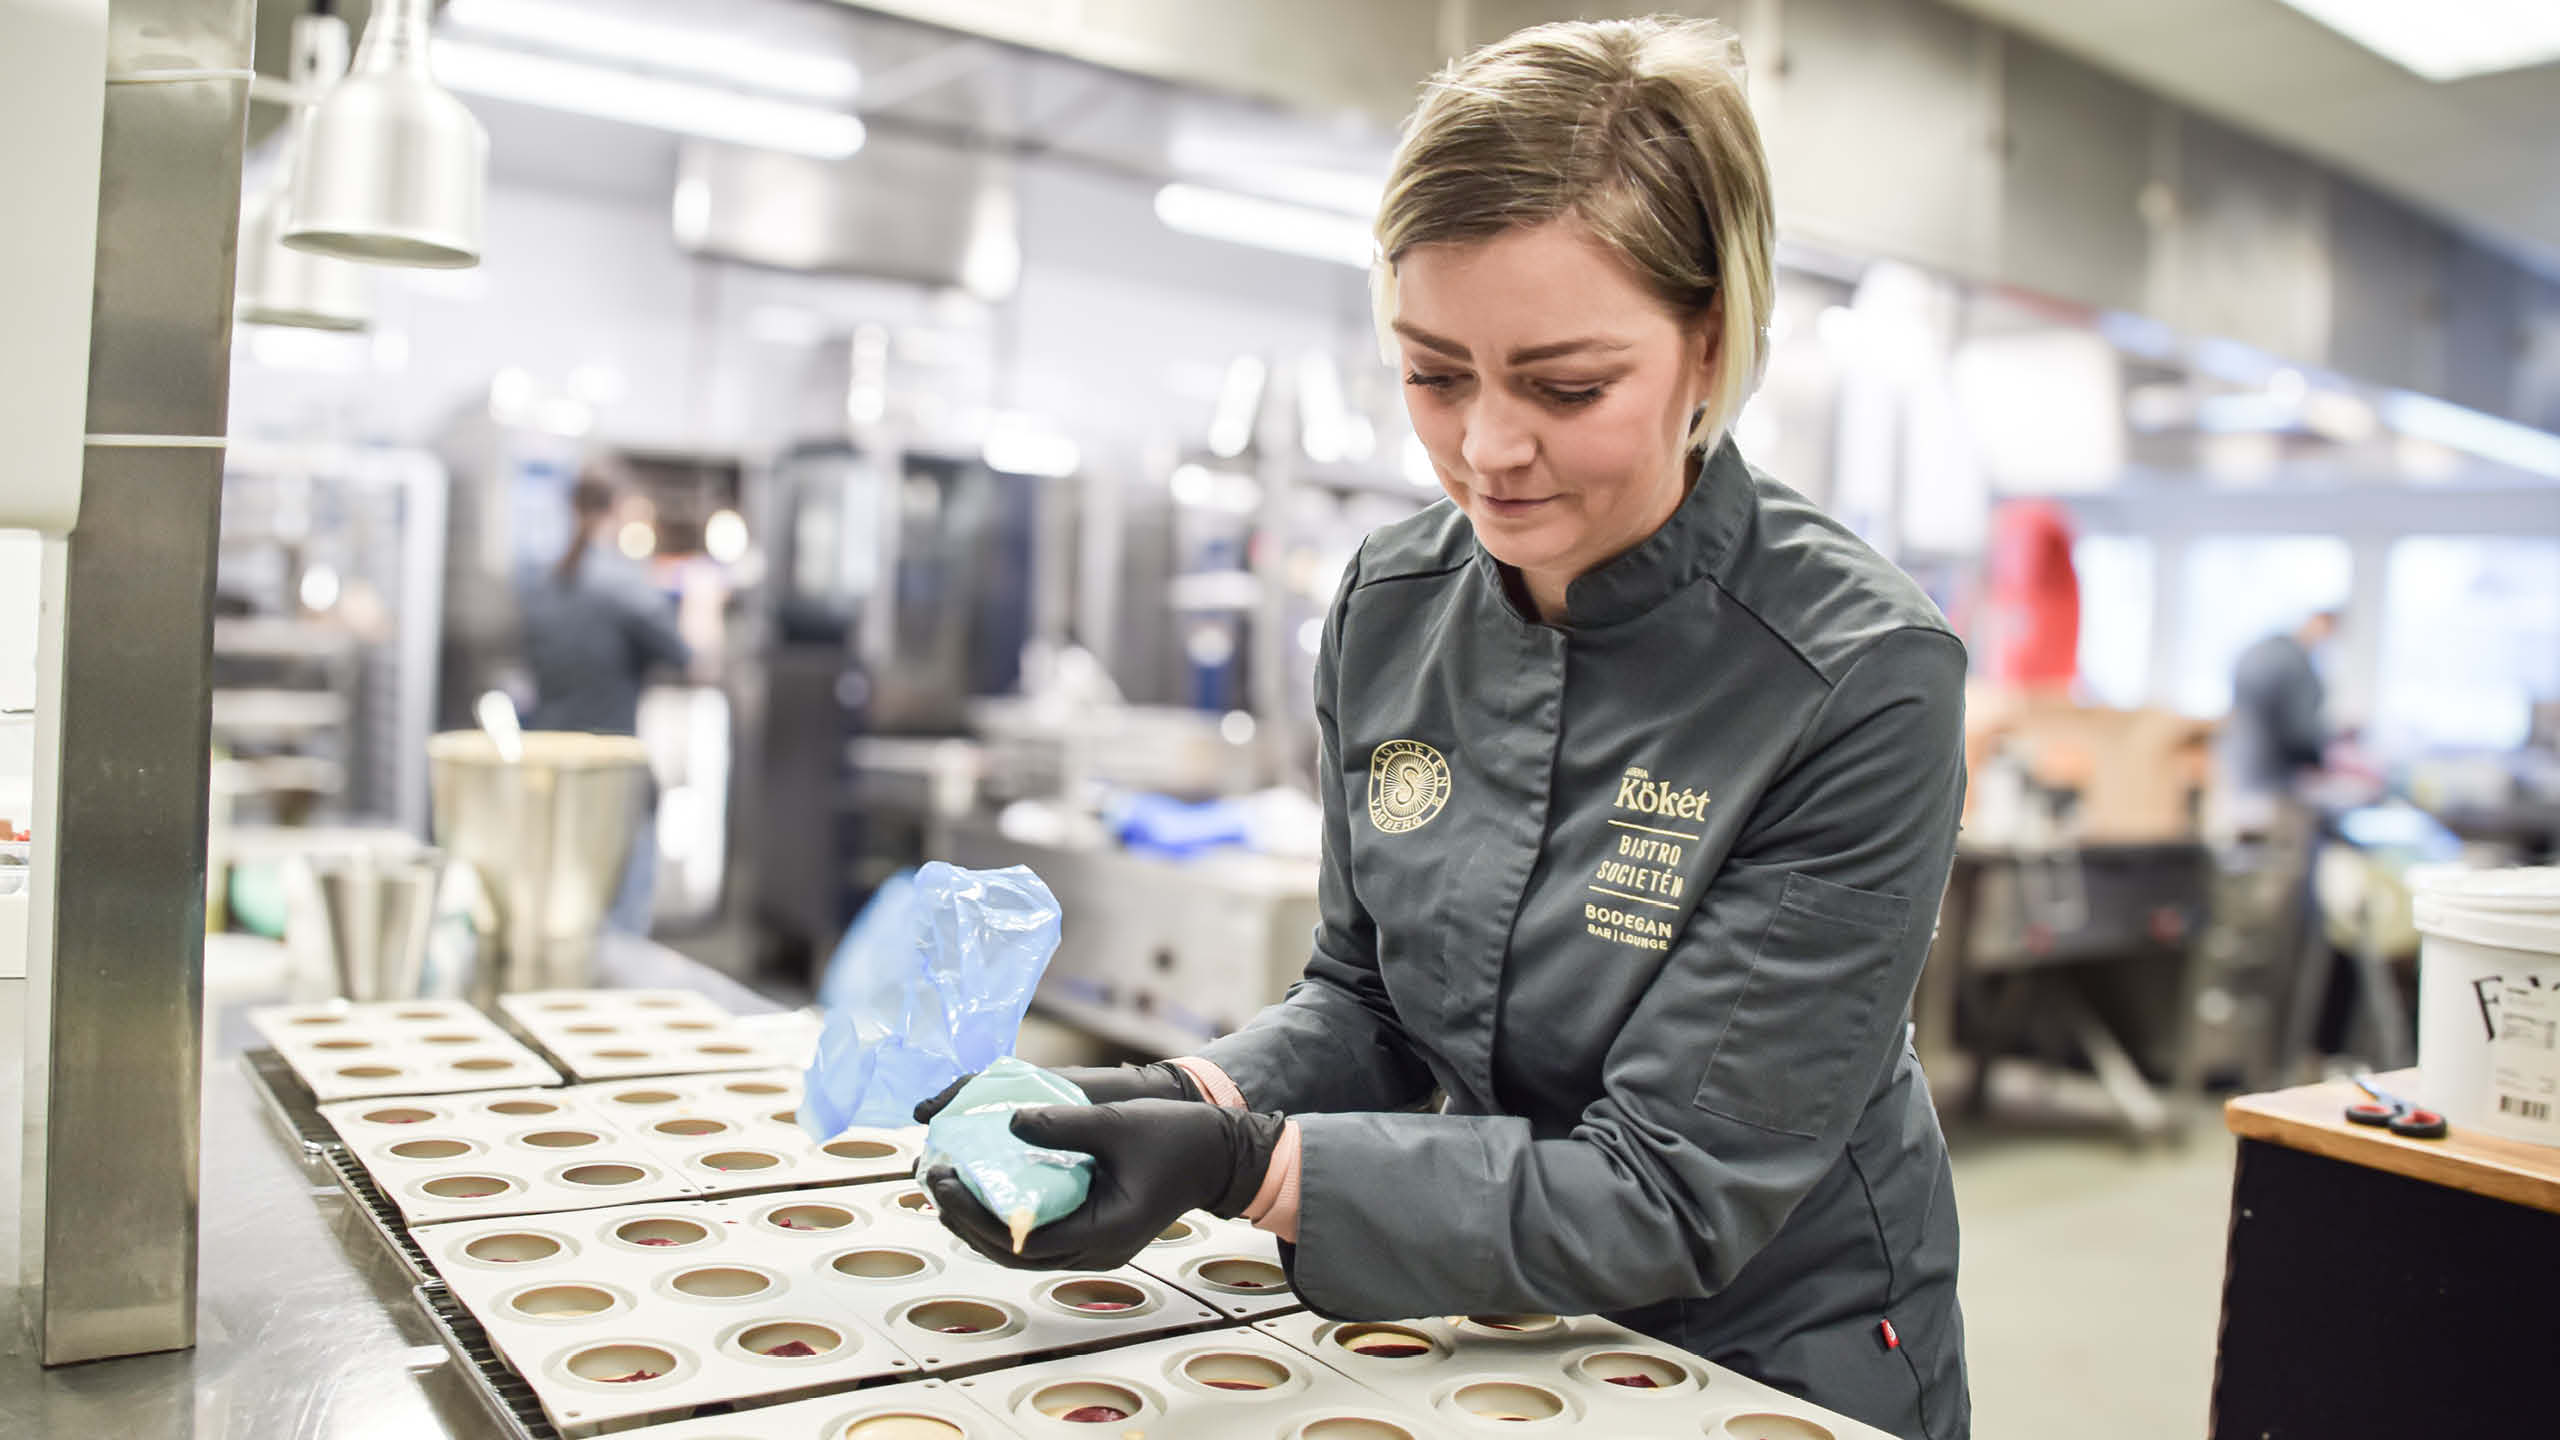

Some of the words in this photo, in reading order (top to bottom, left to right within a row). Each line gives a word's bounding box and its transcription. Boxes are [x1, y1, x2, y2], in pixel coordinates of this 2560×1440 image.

[1370, 796, 1423, 831] VARBERG
[1614, 776, 1711, 822] Kökét
[1618, 834, 1682, 867] BISTRO
[1596, 859, 1684, 898] SOCIETÉN
[1585, 903, 1673, 939] BODEGAN
[1587, 923, 1612, 940] BAR
[1620, 931, 1669, 951] LOUNGE
